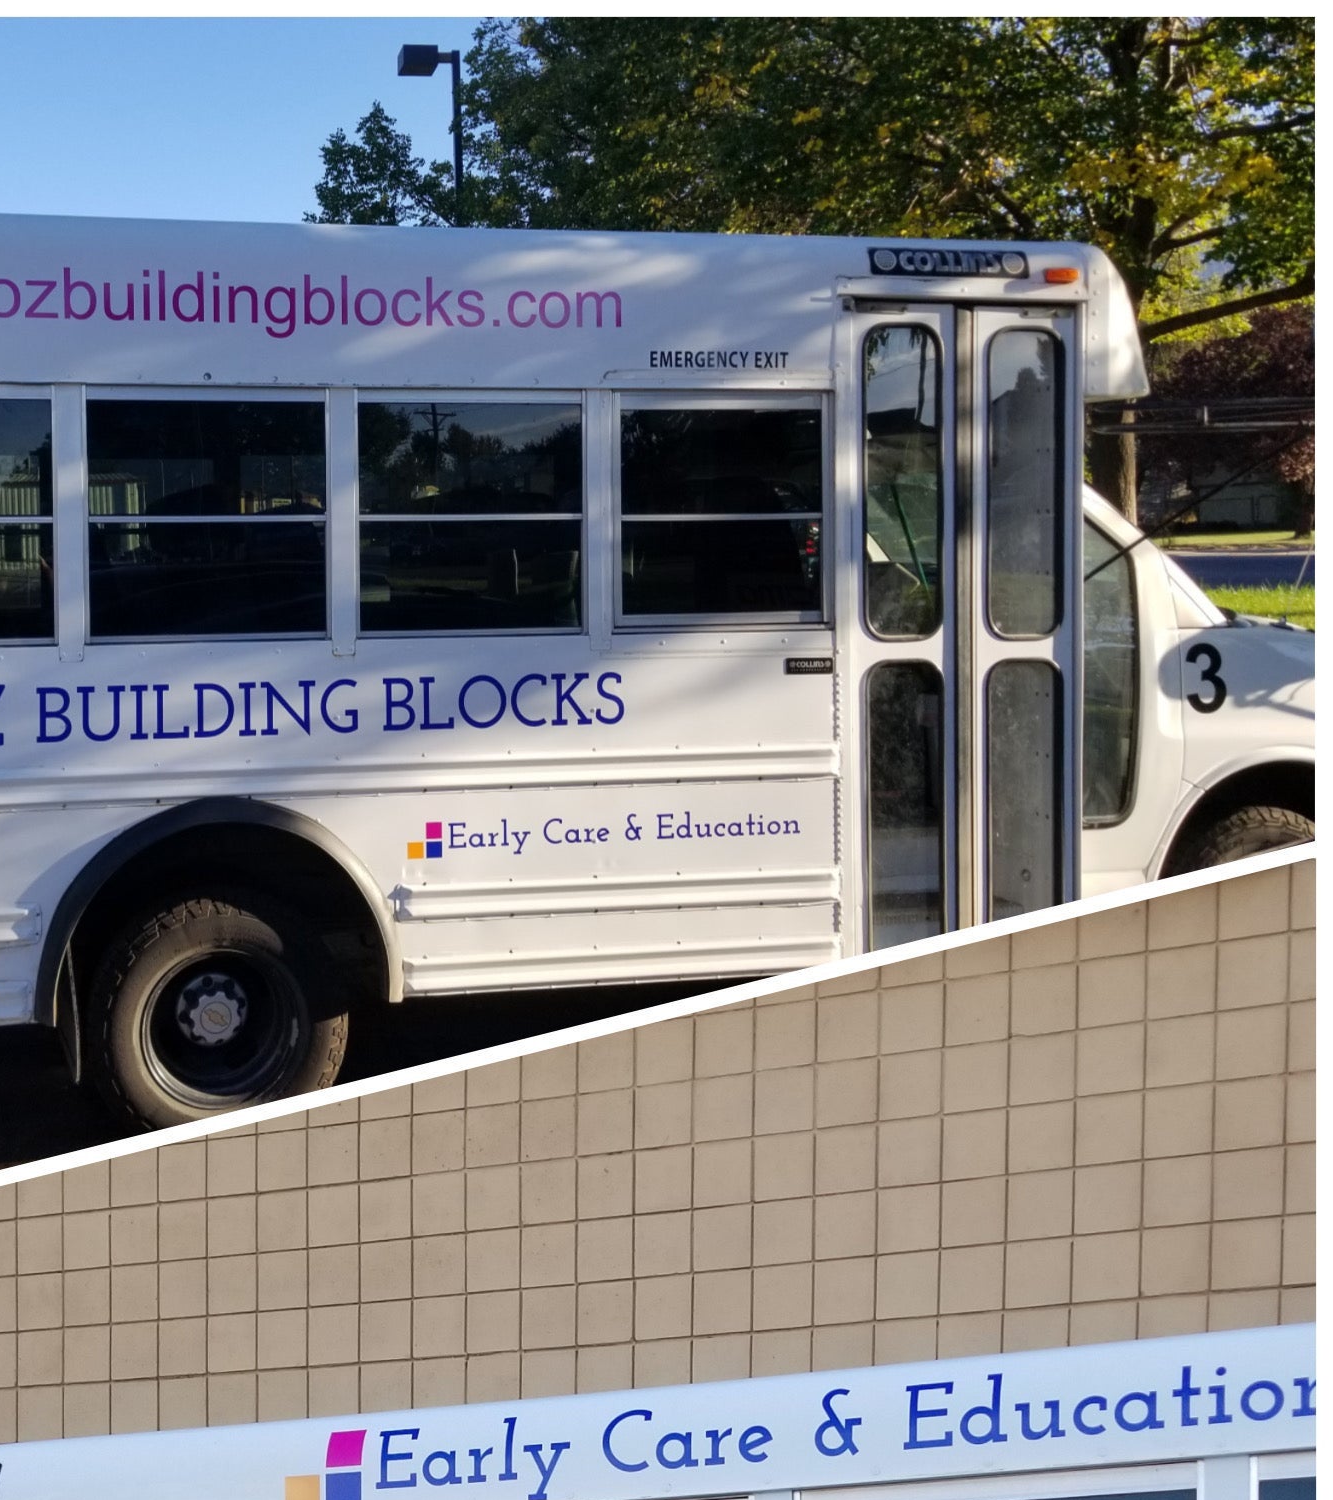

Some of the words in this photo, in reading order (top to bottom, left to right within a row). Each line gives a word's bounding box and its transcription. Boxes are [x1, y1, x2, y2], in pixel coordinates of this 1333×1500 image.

[899, 250, 1001, 273] COLLINS
[649, 351, 749, 368] EMERGENCY
[754, 352, 789, 368] EXIT
[1185, 642, 1227, 713] 3
[36, 679, 360, 743] BUILDING
[382, 672, 625, 731] BLOCKS
[448, 819, 531, 854] Early
[543, 818, 610, 845] Care
[625, 813, 643, 840] &
[656, 812, 801, 840] Education
[601, 1409, 773, 1472] Care
[814, 1388, 863, 1459] &
